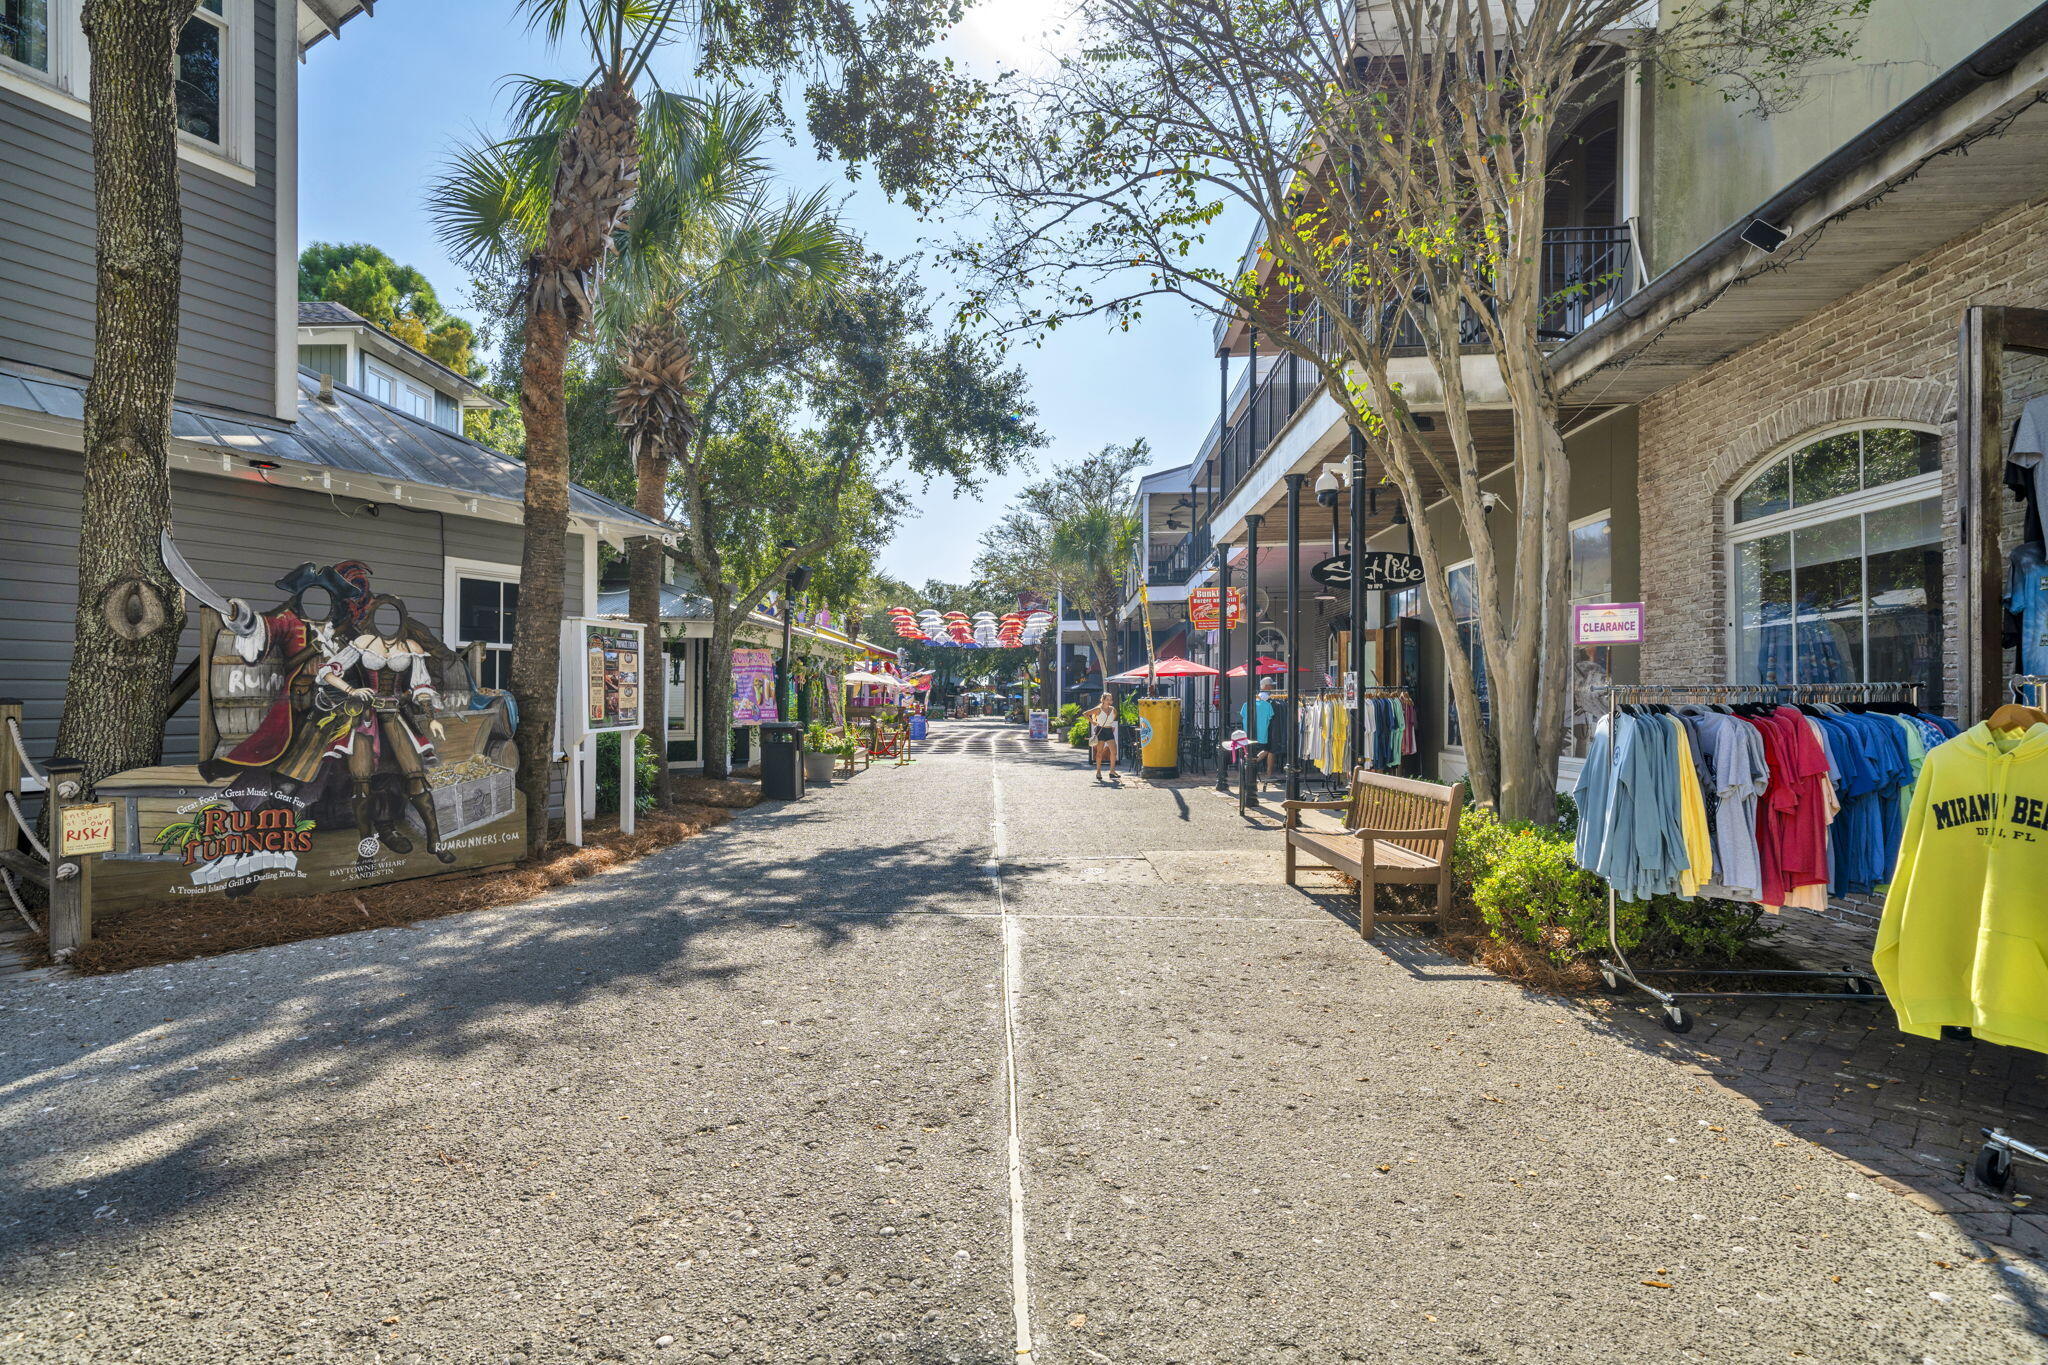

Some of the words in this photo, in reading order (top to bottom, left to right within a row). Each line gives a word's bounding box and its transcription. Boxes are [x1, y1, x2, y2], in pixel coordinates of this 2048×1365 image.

[1583, 621, 1636, 632] CLEARANCE
[176, 802, 198, 815] Great
[199, 792, 218, 806] Food
[225, 788, 245, 798] Great
[246, 787, 268, 797] Music
[274, 790, 292, 803] Great
[292, 796, 306, 809] Fun
[1932, 793, 2007, 830] MIRAM
[66, 826, 109, 842] RISK!
[435, 832, 520, 852] RUMRUNNERS.COM
[2013, 830, 2036, 842] FL
[329, 863, 376, 877] BAYTOWNE
[378, 858, 407, 869] WHARF
[349, 868, 394, 881] SANDESTIN
[169, 885, 176, 894] A
[177, 886, 207, 897] Tropical
[208, 882, 227, 893] Island
[228, 878, 245, 888] Grill
[245, 876, 253, 884] &
[253, 872, 278, 882] Dueling
[279, 870, 296, 878] Piano
